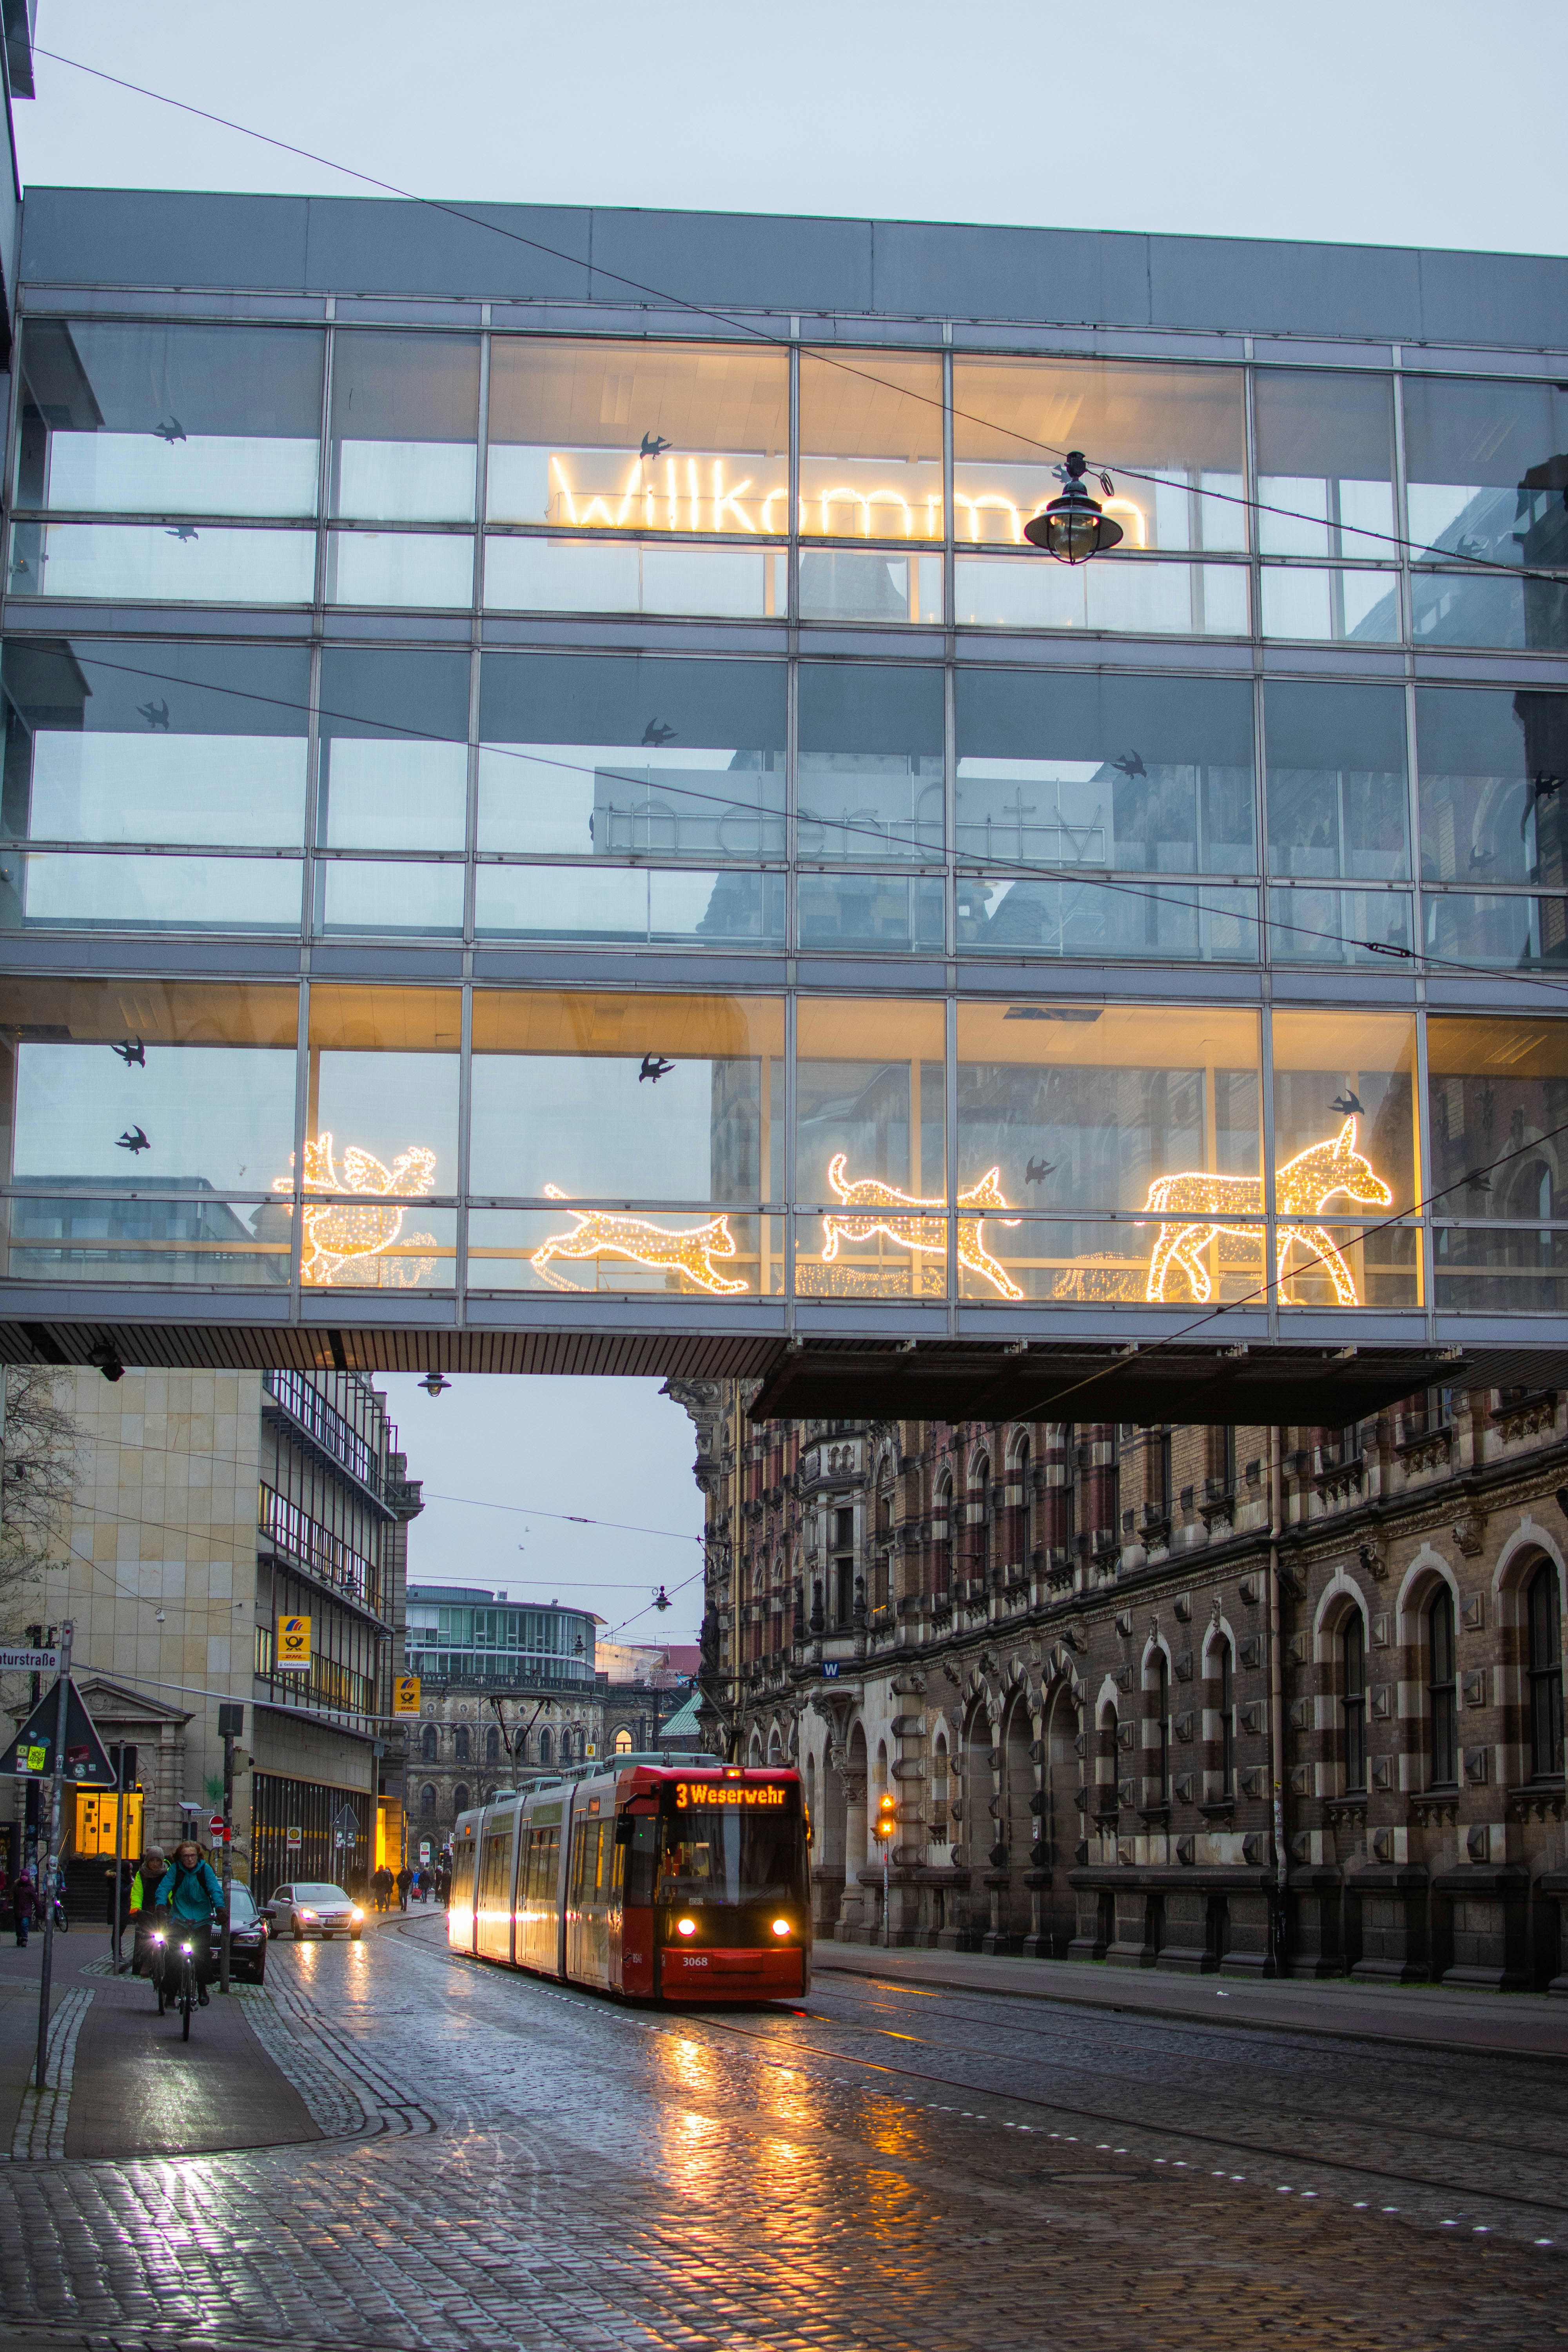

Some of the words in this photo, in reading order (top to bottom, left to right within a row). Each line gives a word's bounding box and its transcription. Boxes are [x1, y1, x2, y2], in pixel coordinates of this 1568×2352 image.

[551, 456, 1146, 549] Willkommn
[824, 1664, 838, 1675] W
[676, 1783, 688, 1808] 3
[690, 1784, 785, 1804] Weserwehr
[682, 1956, 708, 1967] 3068
